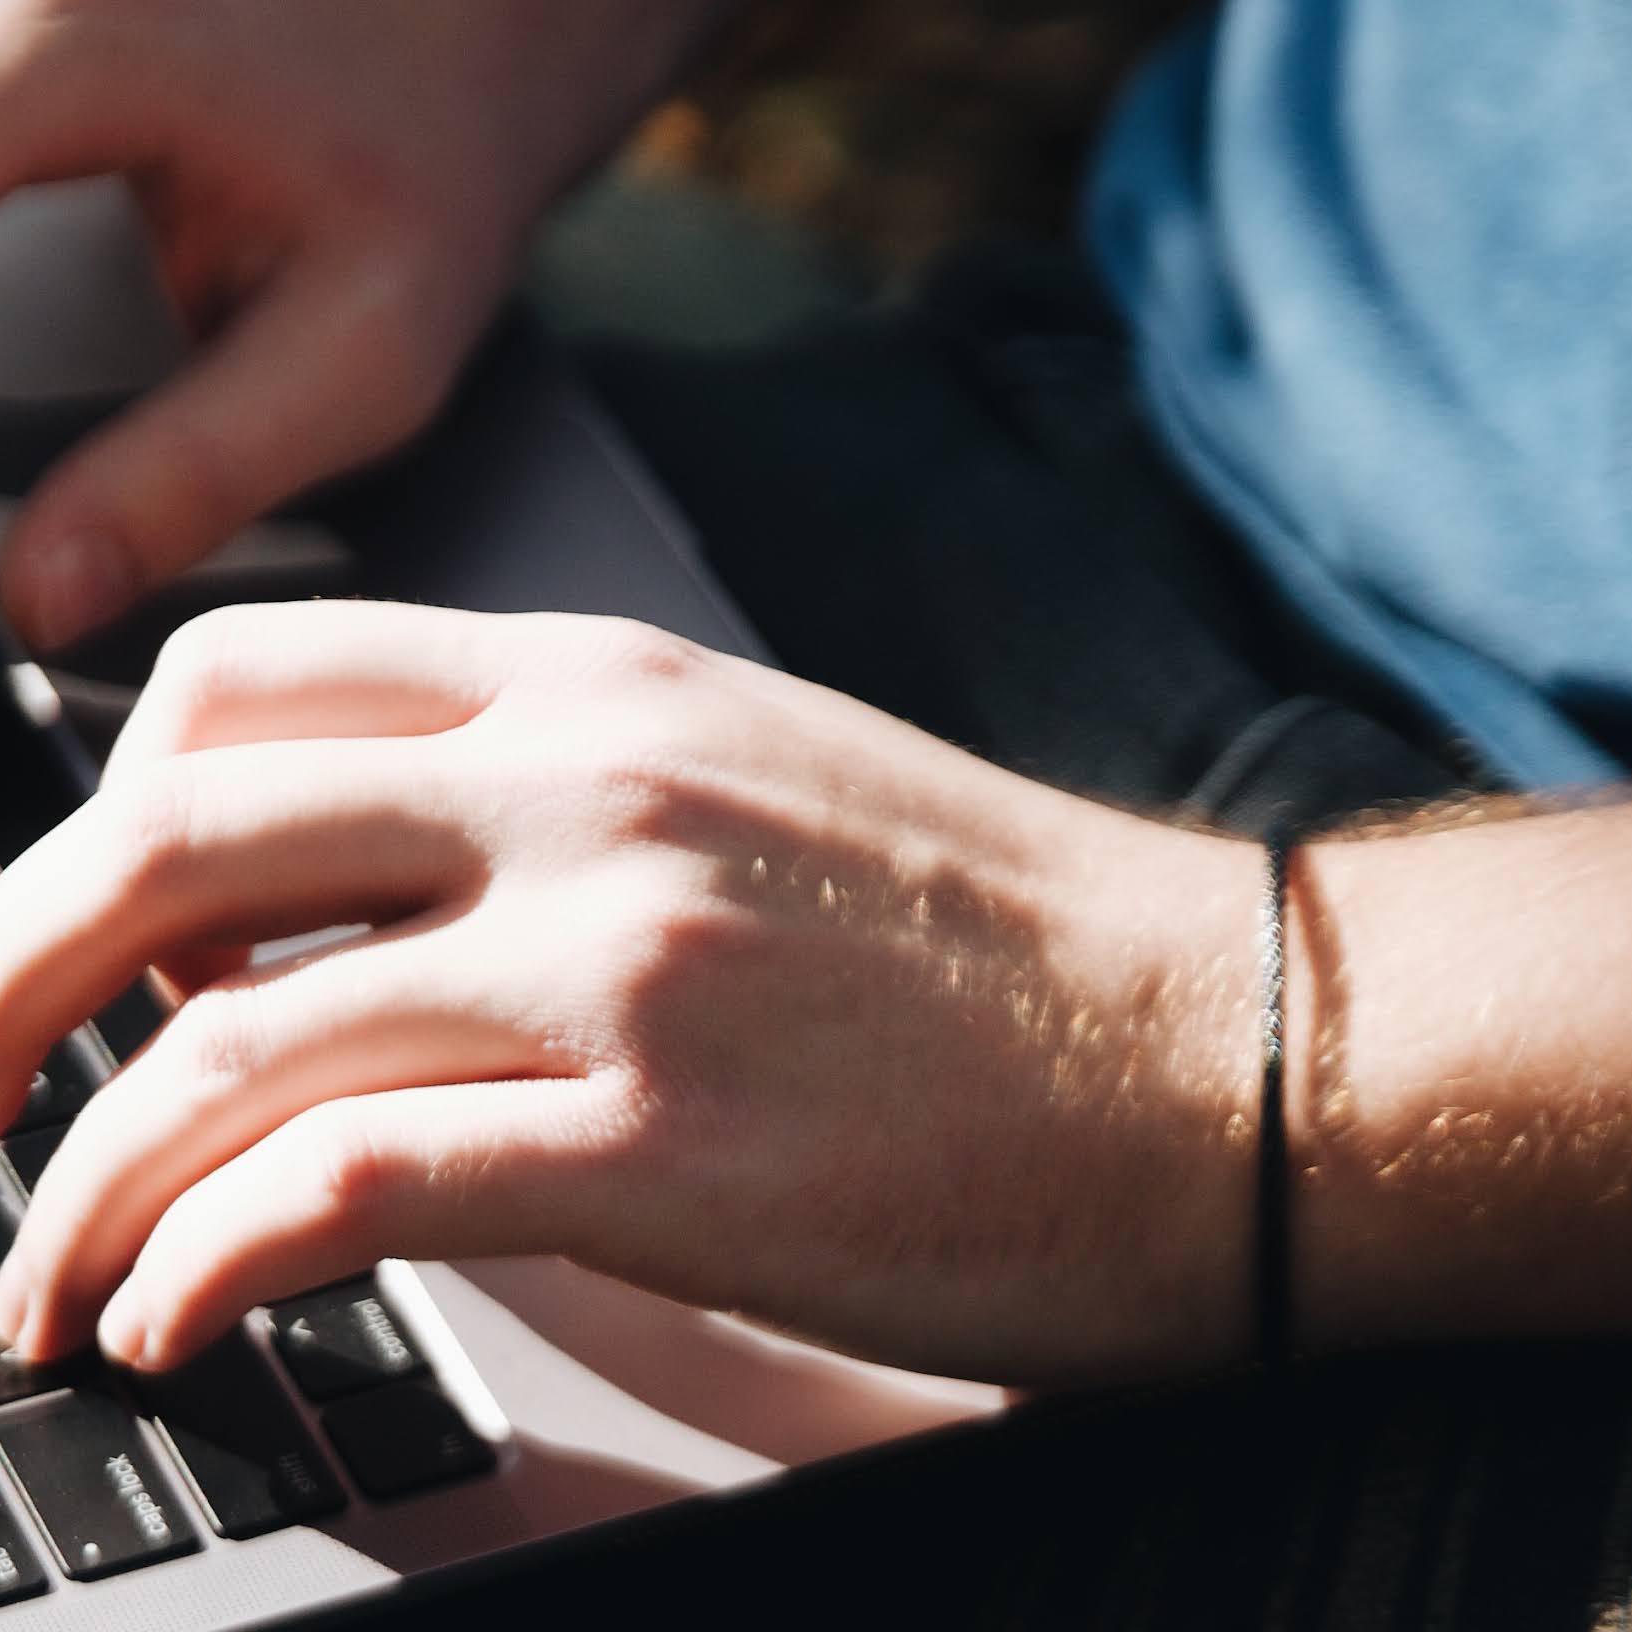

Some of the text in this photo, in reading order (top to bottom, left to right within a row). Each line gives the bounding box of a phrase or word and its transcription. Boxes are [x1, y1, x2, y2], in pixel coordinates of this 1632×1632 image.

[351, 1297, 410, 1362] control
[106, 1453, 170, 1539] caps lock
